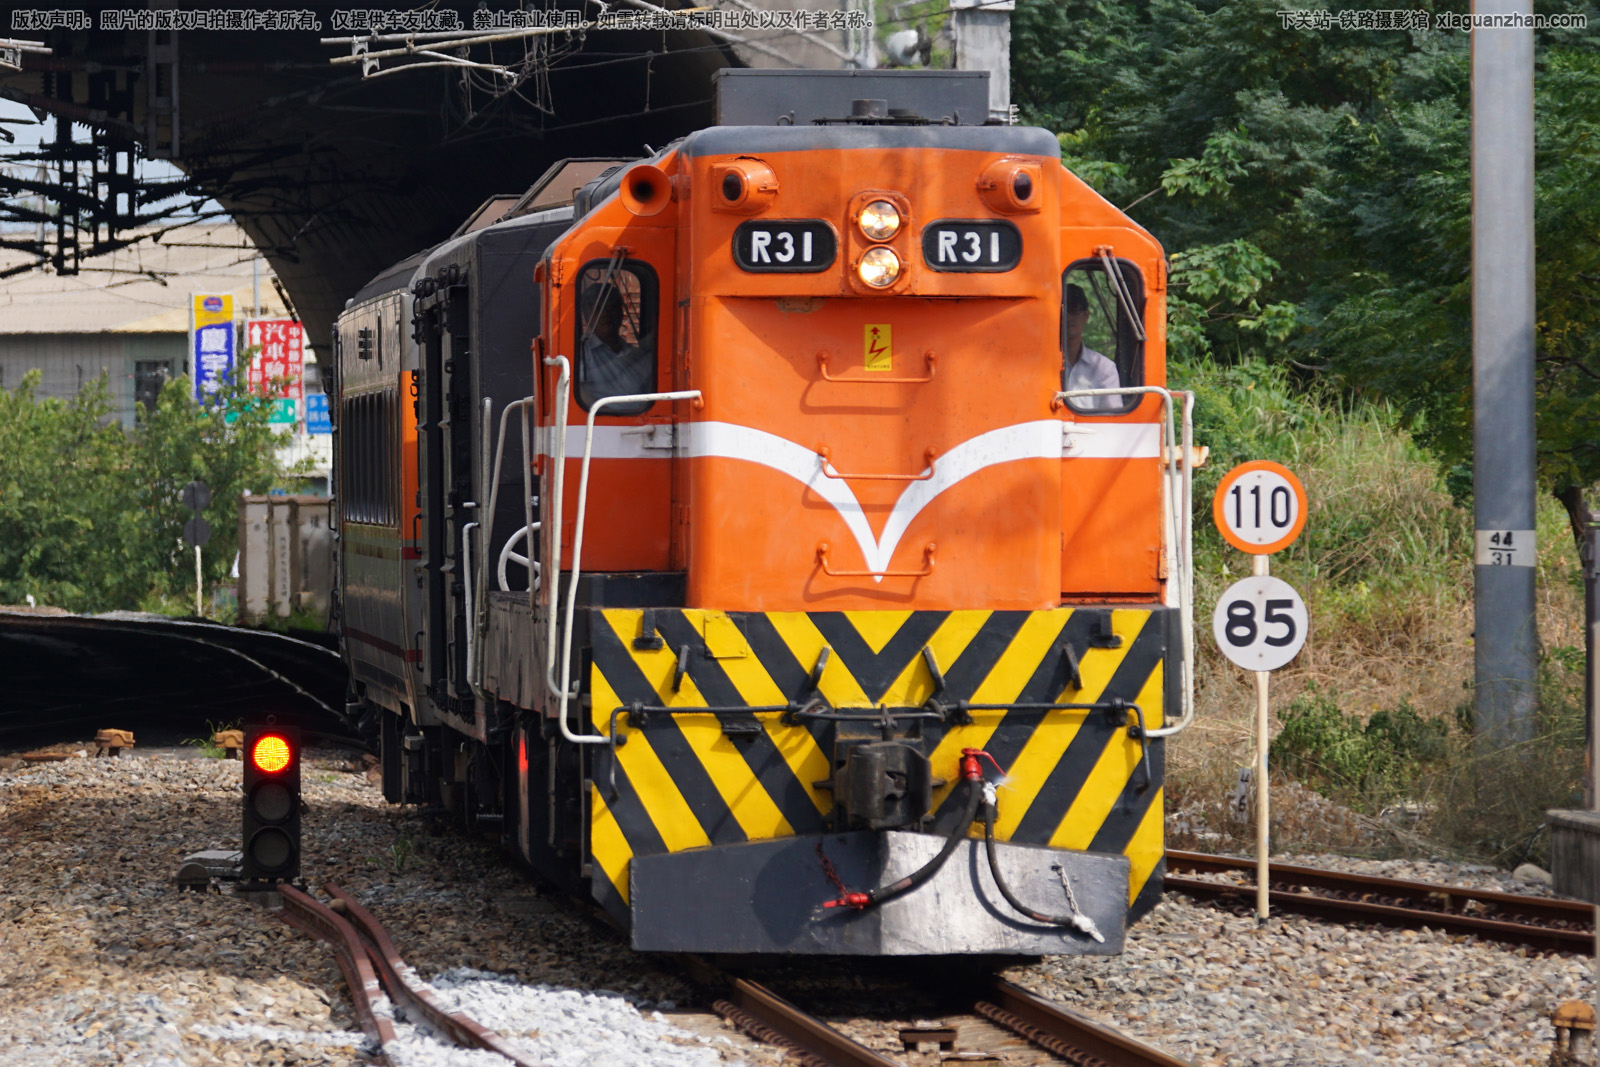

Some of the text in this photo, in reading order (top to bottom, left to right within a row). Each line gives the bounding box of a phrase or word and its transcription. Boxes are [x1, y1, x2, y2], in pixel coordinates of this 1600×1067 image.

[752, 230, 813, 263] R31
[938, 230, 1000, 263] R31
[1231, 485, 1293, 529] 110
[1491, 552, 1513, 566] 31
[1225, 599, 1297, 647] 85
